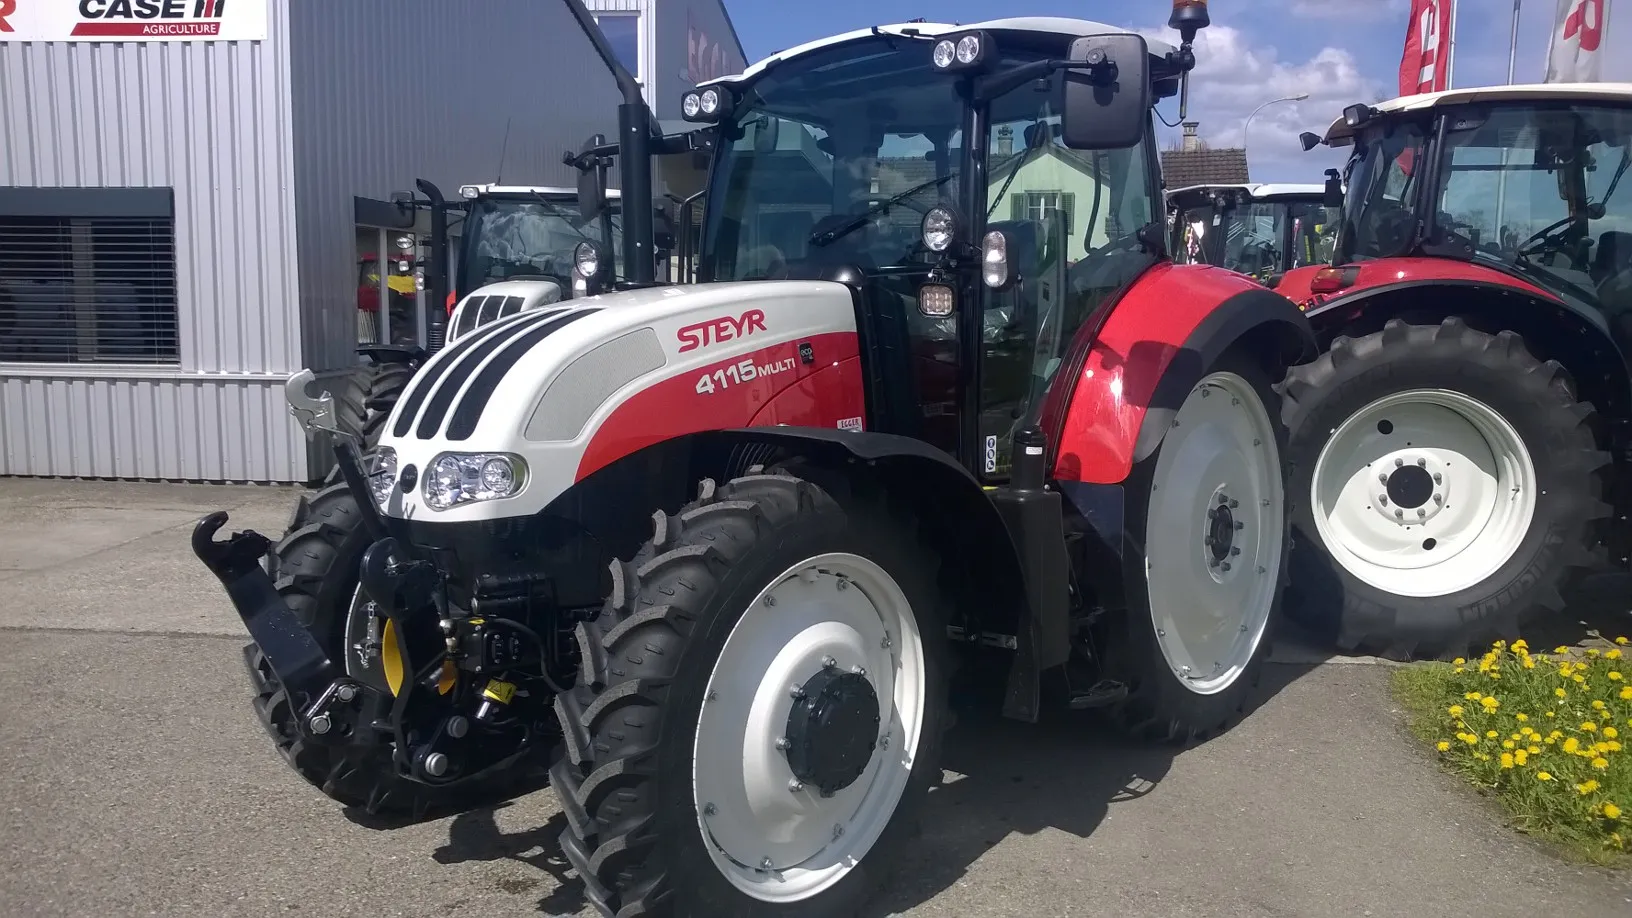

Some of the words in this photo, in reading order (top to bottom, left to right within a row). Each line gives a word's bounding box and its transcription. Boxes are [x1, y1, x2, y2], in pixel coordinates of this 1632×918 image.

[79, 0, 186, 19] CASE
[143, 24, 217, 34] AGRICULTURE
[677, 309, 767, 353] STEYR
[695, 359, 757, 395] 4115
[757, 357, 796, 379] MULTI
